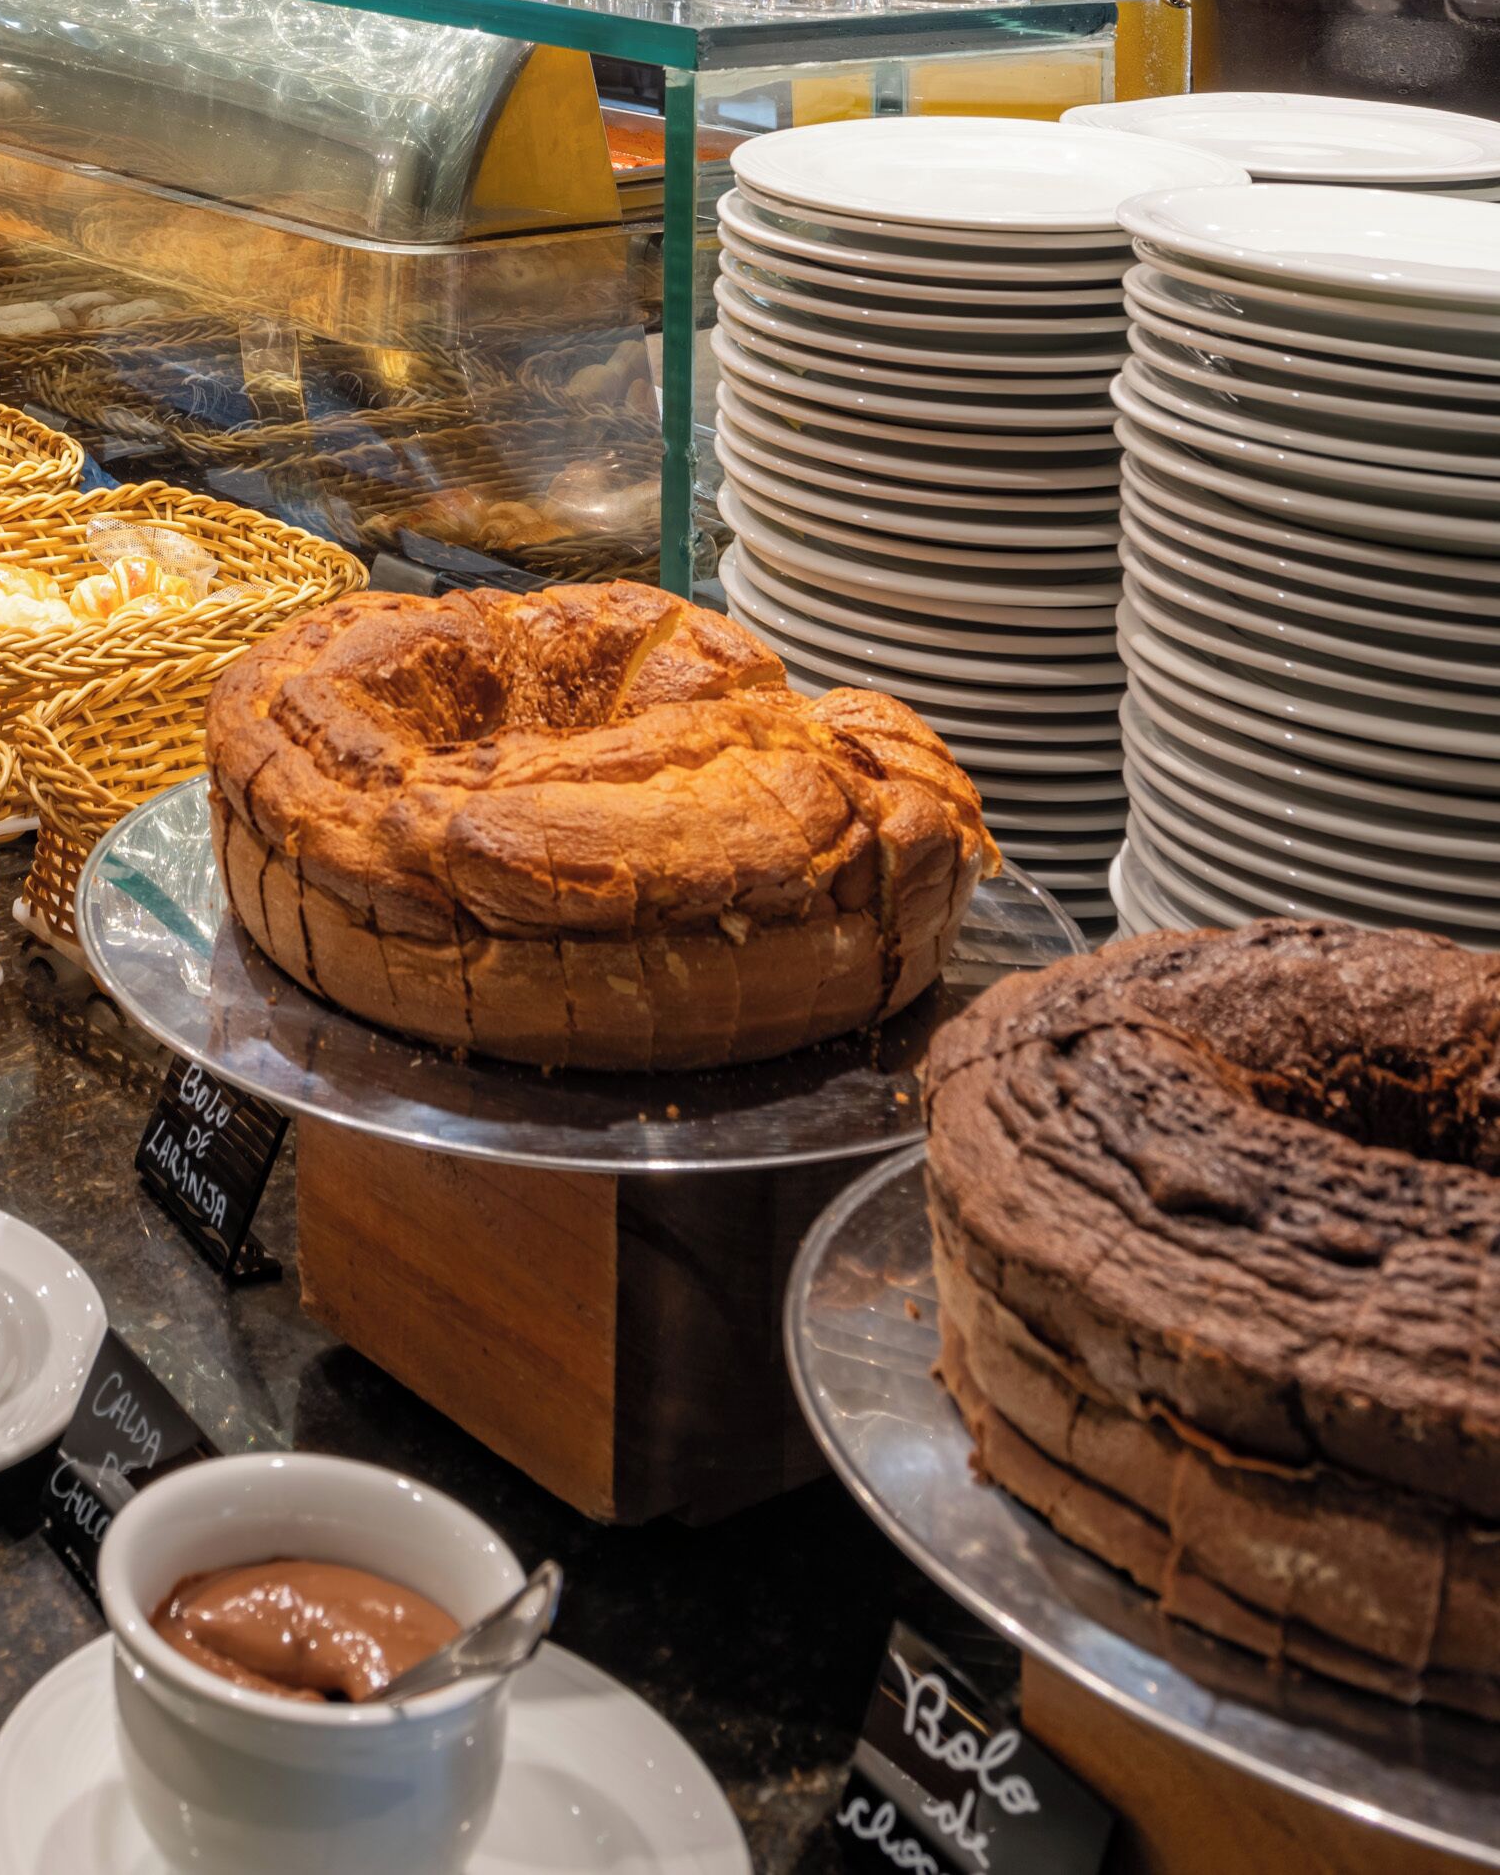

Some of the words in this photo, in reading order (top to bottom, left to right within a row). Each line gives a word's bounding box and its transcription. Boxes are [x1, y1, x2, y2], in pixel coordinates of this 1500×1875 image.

[145, 1119, 228, 1229] LARANJA
[184, 1124, 214, 1159] DE
[92, 1372, 161, 1469] CALDA
[889, 1650, 1041, 1815] Bolo
[921, 1789, 990, 1870] de
